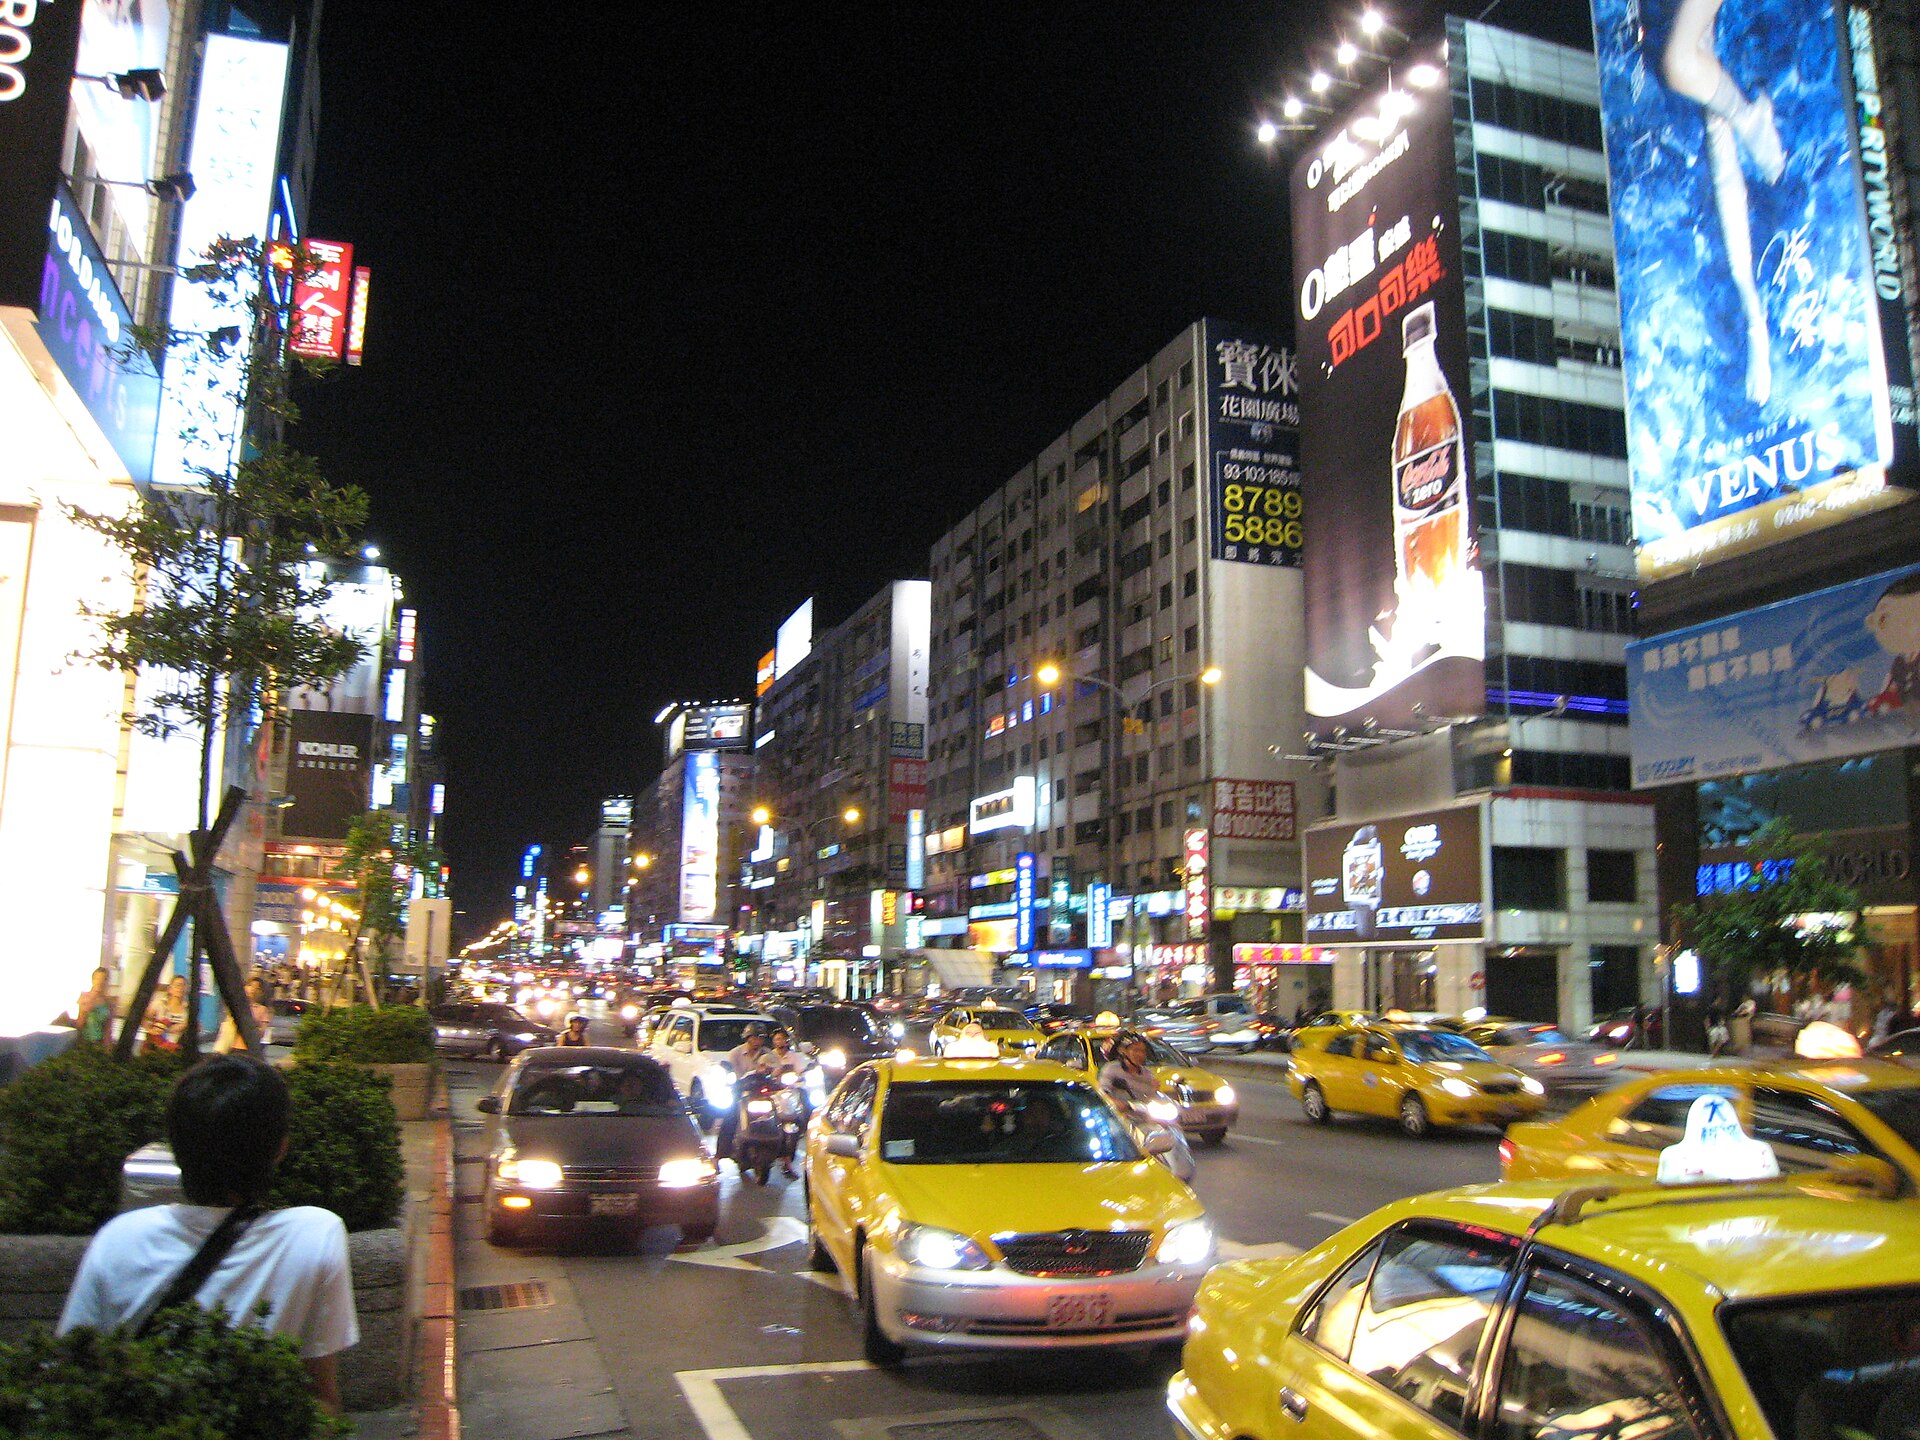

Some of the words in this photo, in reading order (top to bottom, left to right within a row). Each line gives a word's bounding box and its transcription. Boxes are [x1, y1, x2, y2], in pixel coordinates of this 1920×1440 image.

[1327, 233, 1441, 368] 可口可樂
[1683, 421, 1840, 517] VENUS
[1223, 484, 1303, 519] 8789
[1224, 514, 1304, 549] 5886
[297, 740, 360, 759] KOHLER
[1703, 1099, 1727, 1123] 大
